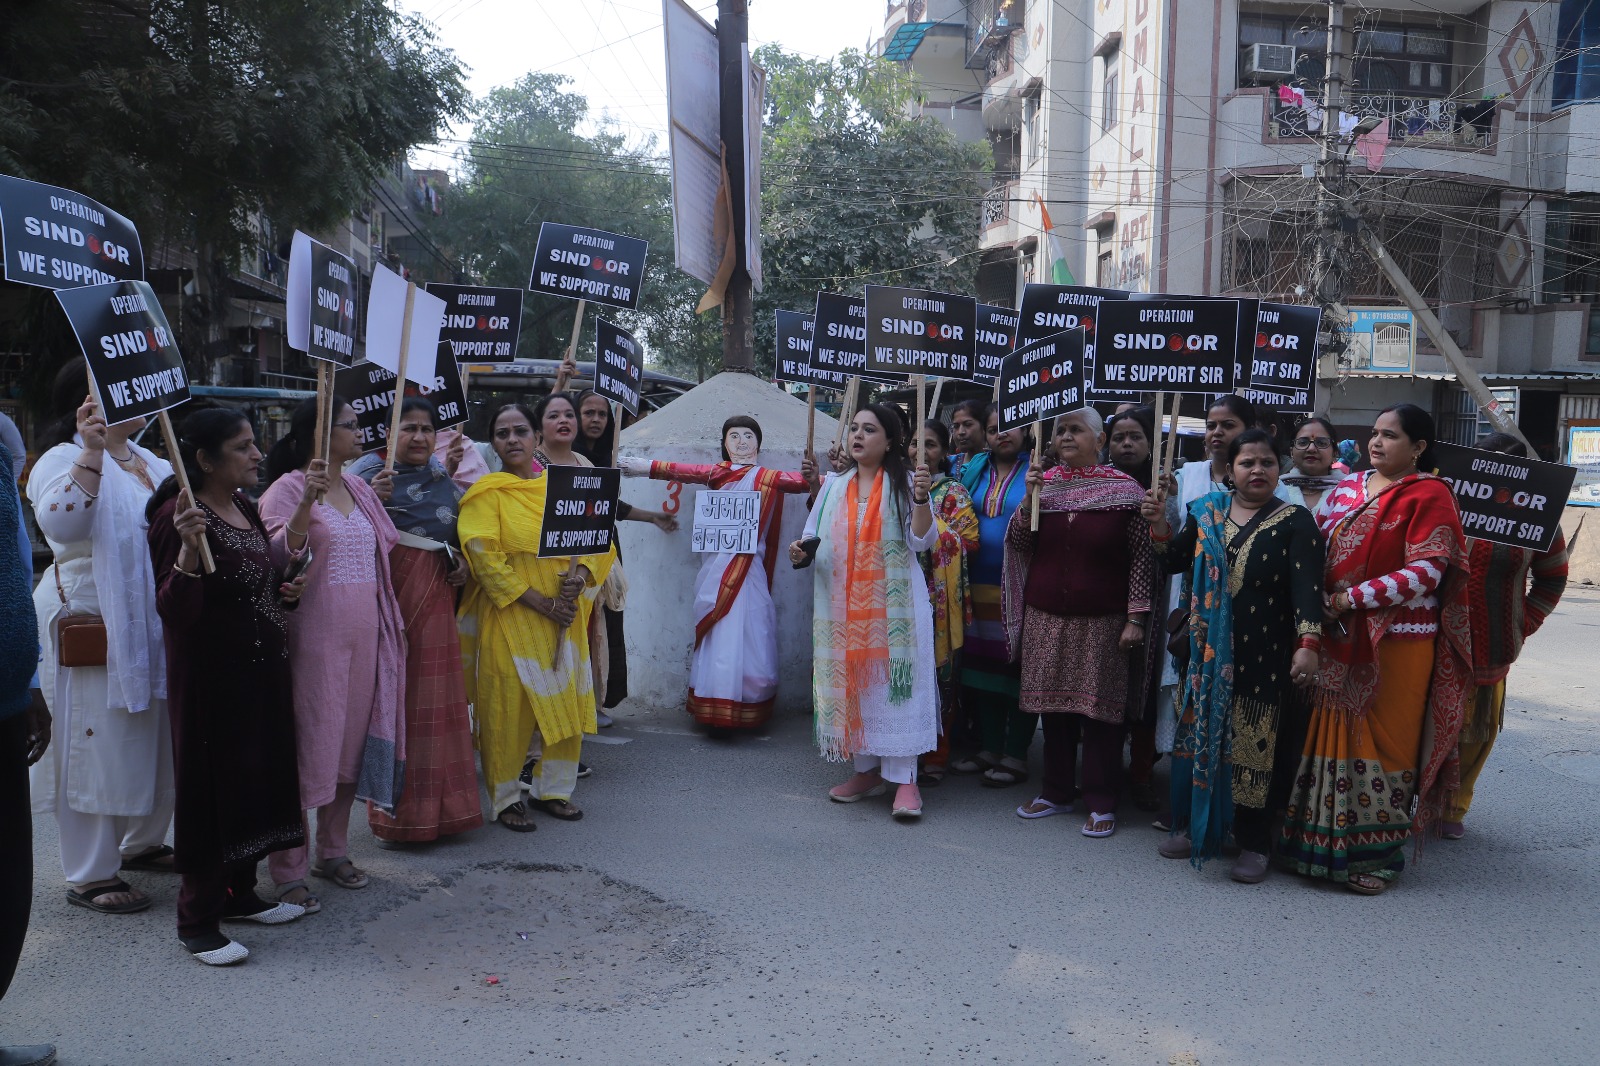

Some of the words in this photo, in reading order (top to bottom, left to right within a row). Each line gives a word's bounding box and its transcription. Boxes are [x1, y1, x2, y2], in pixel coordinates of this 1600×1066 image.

[50, 195, 105, 227] OPERATION
[572, 233, 615, 250] OPERATION
[18, 250, 47, 275] WE
[540, 271, 558, 287] WE
[559, 275, 610, 297] SUPPORT
[612, 285, 631, 301] SIR
[110, 294, 149, 316] OPERATION
[457, 293, 496, 306] OPERATION
[902, 296, 945, 314] OPERATION
[1139, 309, 1194, 323] OPERATION
[313, 324, 324, 347] WE
[324, 327, 346, 354] SUPPORT
[494, 342, 511, 356] SIR
[818, 347, 835, 364] WE
[874, 346, 893, 364] WE
[896, 348, 949, 369] SUPPORT
[950, 353, 968, 371] SIR
[1022, 343, 1056, 365] OPERATION
[782, 359, 796, 374] WE
[1104, 364, 1126, 382] WE
[1130, 364, 1196, 383] SUPPORT
[1199, 366, 1224, 384] SIR
[1278, 361, 1302, 380] SIR
[108, 381, 133, 408] WE
[132, 370, 175, 402] SUPPORT
[171, 366, 186, 389] SIR
[600, 372, 610, 390] WE
[437, 401, 460, 421] SIR
[1003, 406, 1017, 422] WE
[1018, 392, 1060, 418] SUPPORT
[1062, 387, 1078, 406] SIR
[1471, 458, 1529, 481] OPERATION
[573, 476, 602, 489] OPERATION
[546, 531, 561, 548] WE
[560, 530, 597, 547] SUPPORT
[597, 529, 609, 546] SIR
[1517, 522, 1545, 542] SIR
